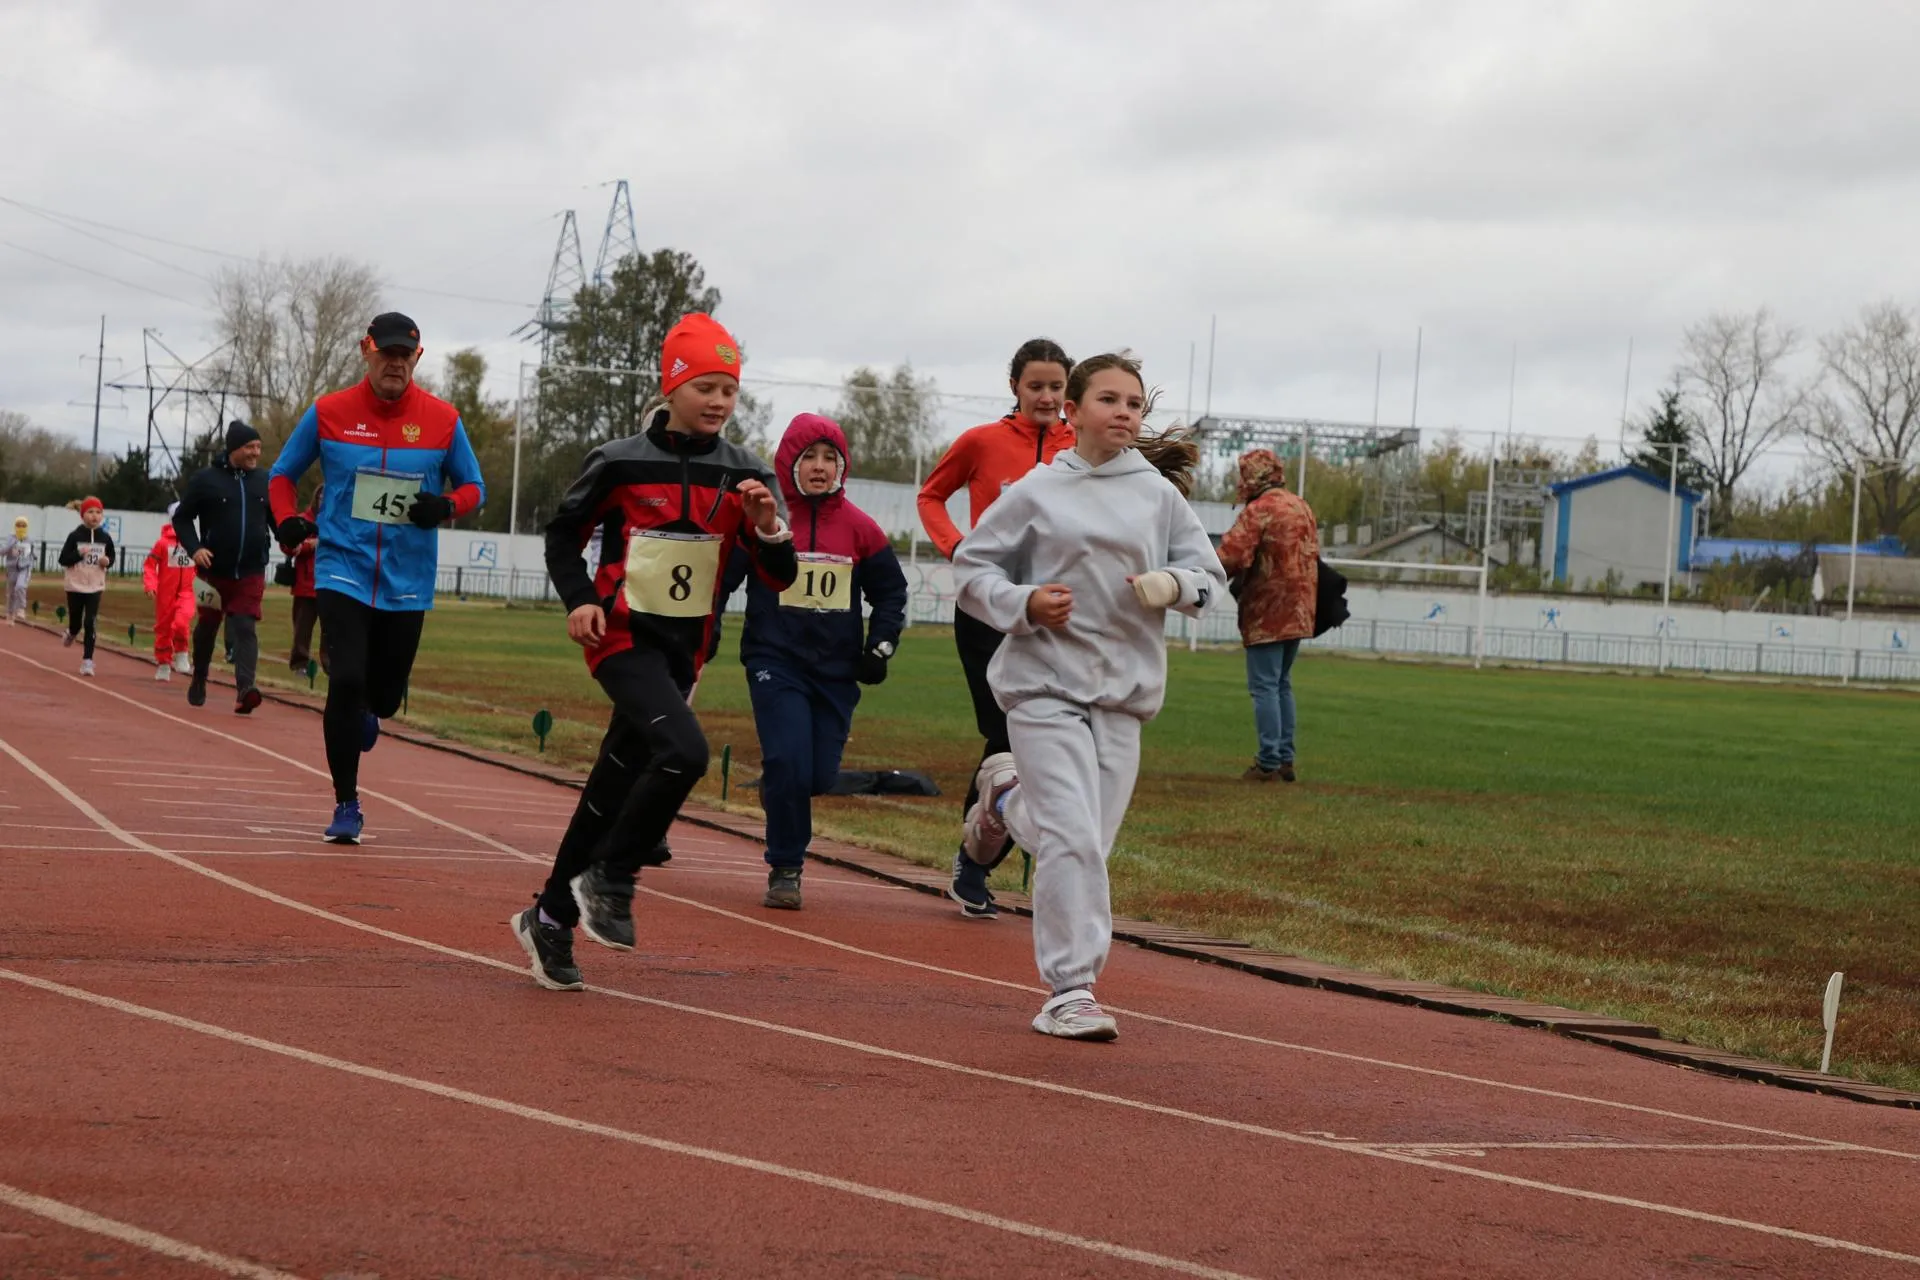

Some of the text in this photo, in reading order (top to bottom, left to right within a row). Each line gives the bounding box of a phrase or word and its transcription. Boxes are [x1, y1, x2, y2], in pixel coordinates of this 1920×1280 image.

[372, 491, 407, 518] 45
[87, 554, 99, 565] 32
[177, 554, 190, 566] 85
[669, 564, 693, 601] 8
[803, 569, 837, 598] 10
